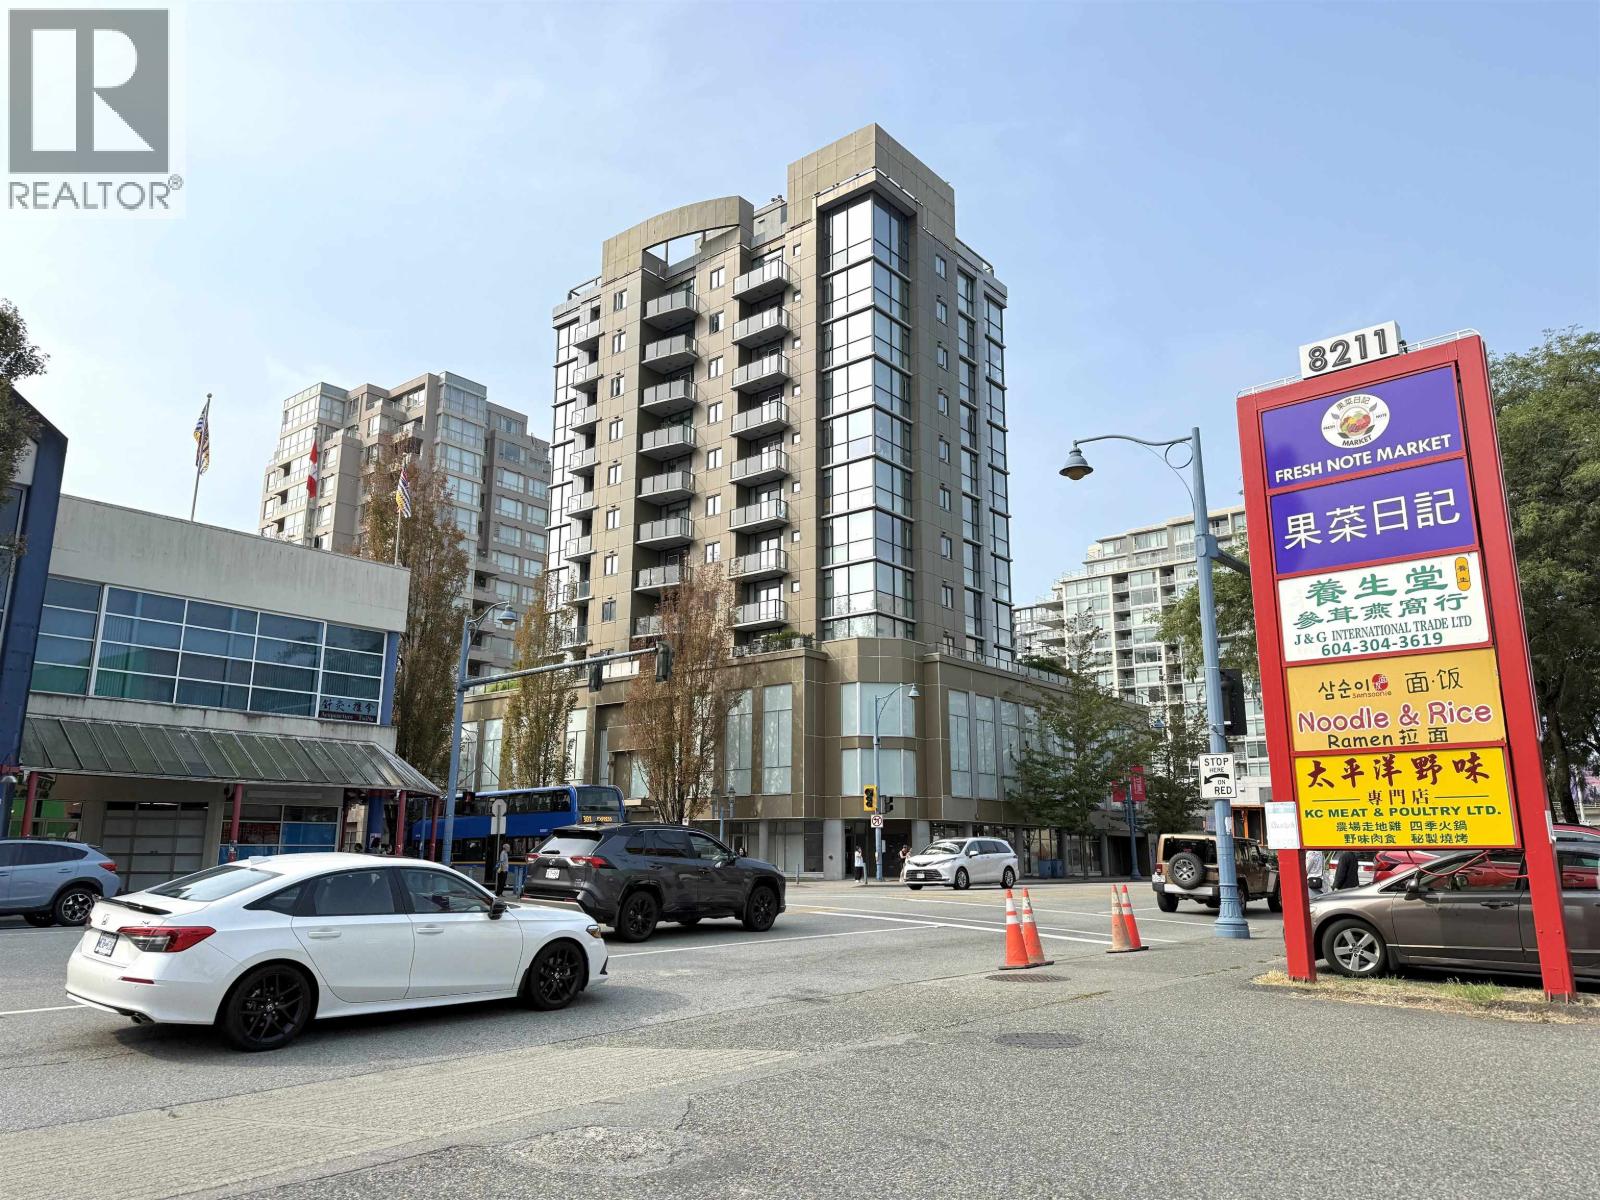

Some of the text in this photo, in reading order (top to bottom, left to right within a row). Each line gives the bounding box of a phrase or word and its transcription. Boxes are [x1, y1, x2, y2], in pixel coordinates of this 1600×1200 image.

[1308, 328, 1387, 372] 8211
[1342, 434, 1372, 446] MARKET
[1275, 434, 1451, 483] FRESH NOTE MARKET
[1284, 488, 1461, 550] 果菜日記
[1305, 564, 1449, 607] 養生堂
[1332, 622, 1411, 641] INTERNATIONAL
[1413, 617, 1449, 632] TRADE
[1451, 615, 1472, 628] LTD
[1322, 632, 1443, 656] 604-304-3619
[1318, 678, 1370, 700] 삼순이
[1298, 700, 1492, 733] Noodle & Rice
[1327, 733, 1393, 749] Ramen
[1204, 757, 1229, 767] STOP
[1308, 751, 1490, 788] 太平洋野味
[1214, 786, 1232, 795] RED
[1368, 788, 1429, 805] 專門店
[1305, 809, 1323, 818] KC
[1328, 808, 1368, 818] MEAT
[1374, 807, 1384, 817] &
[1389, 806, 1461, 816] POULTRY
[1467, 805, 1501, 815] LTD.
[1344, 833, 1396, 844] 野味肉食
